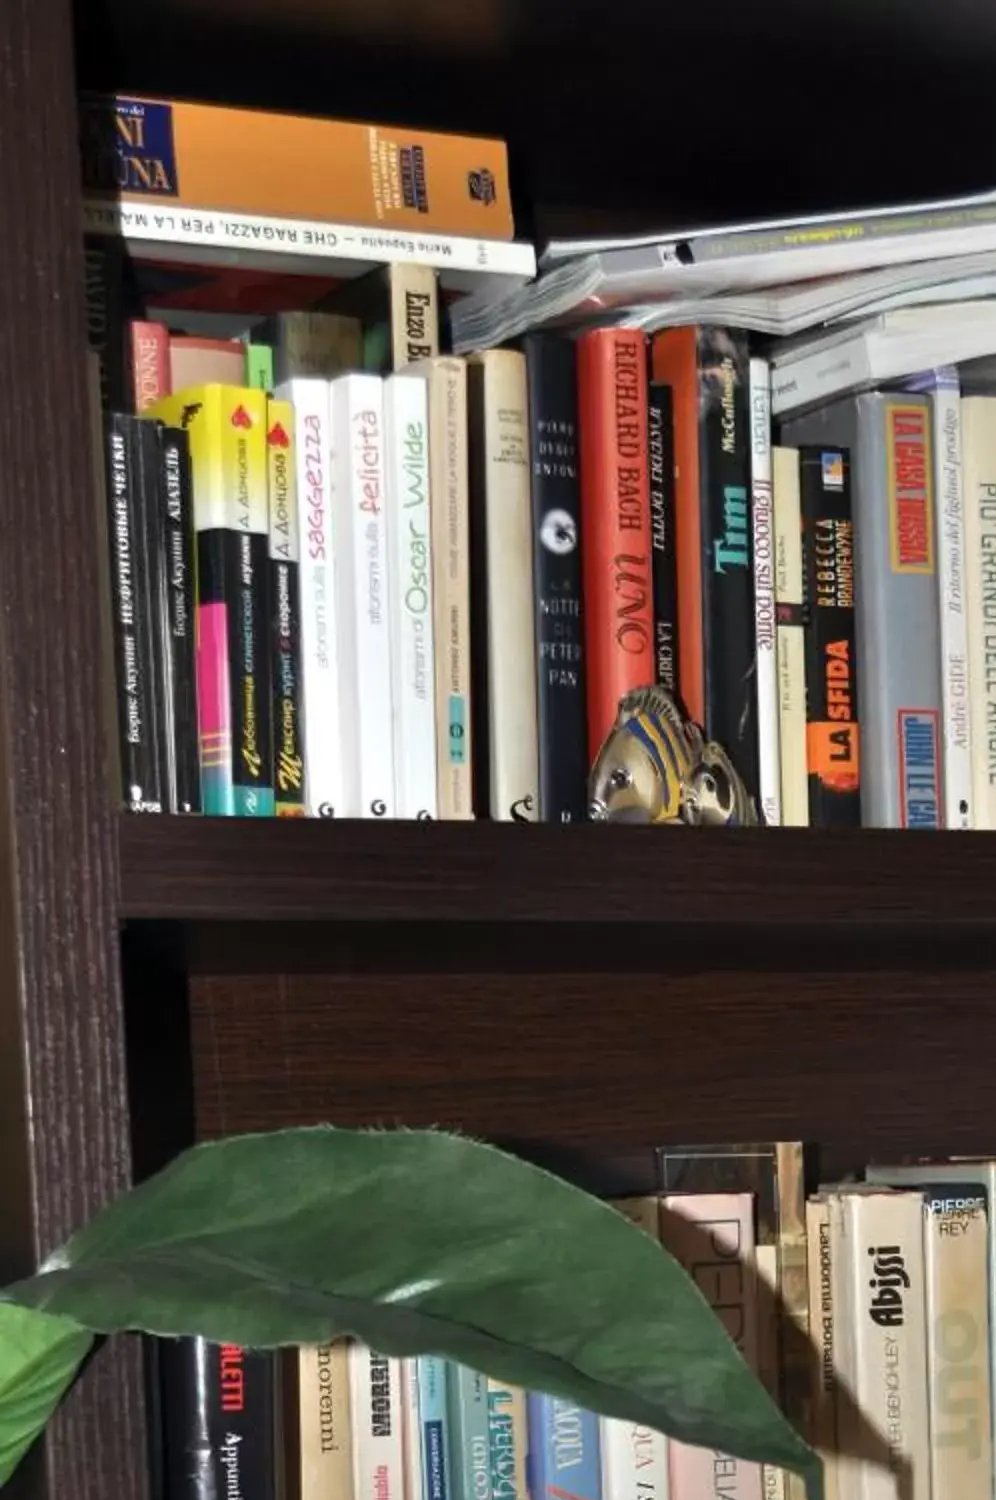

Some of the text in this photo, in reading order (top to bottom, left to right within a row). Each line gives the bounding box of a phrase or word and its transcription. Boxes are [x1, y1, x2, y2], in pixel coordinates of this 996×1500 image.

[153, 215, 174, 231] LA
[181, 217, 214, 234] PER
[303, 229, 338, 246] CHE
[417, 242, 453, 256] Mario
[404, 290, 431, 339] Enzo
[613, 340, 643, 460] RICHARD
[165, 446, 182, 522] АЗАЗЕЛЬ
[271, 453, 289, 537] Донцова
[353, 409, 383, 516] felicità
[617, 465, 643, 533] BACH
[893, 411, 929, 565] LA CASA RUSSIA
[403, 421, 429, 614] Oscar Wilde
[712, 485, 751, 575] Tim
[816, 519, 836, 607] REBECCA
[825, 639, 851, 762] LA SFIDA
[904, 717, 937, 794] JOHN LE
[885, 1336, 901, 1418] BENCHLEY
[934, 1309, 981, 1462] OUT
